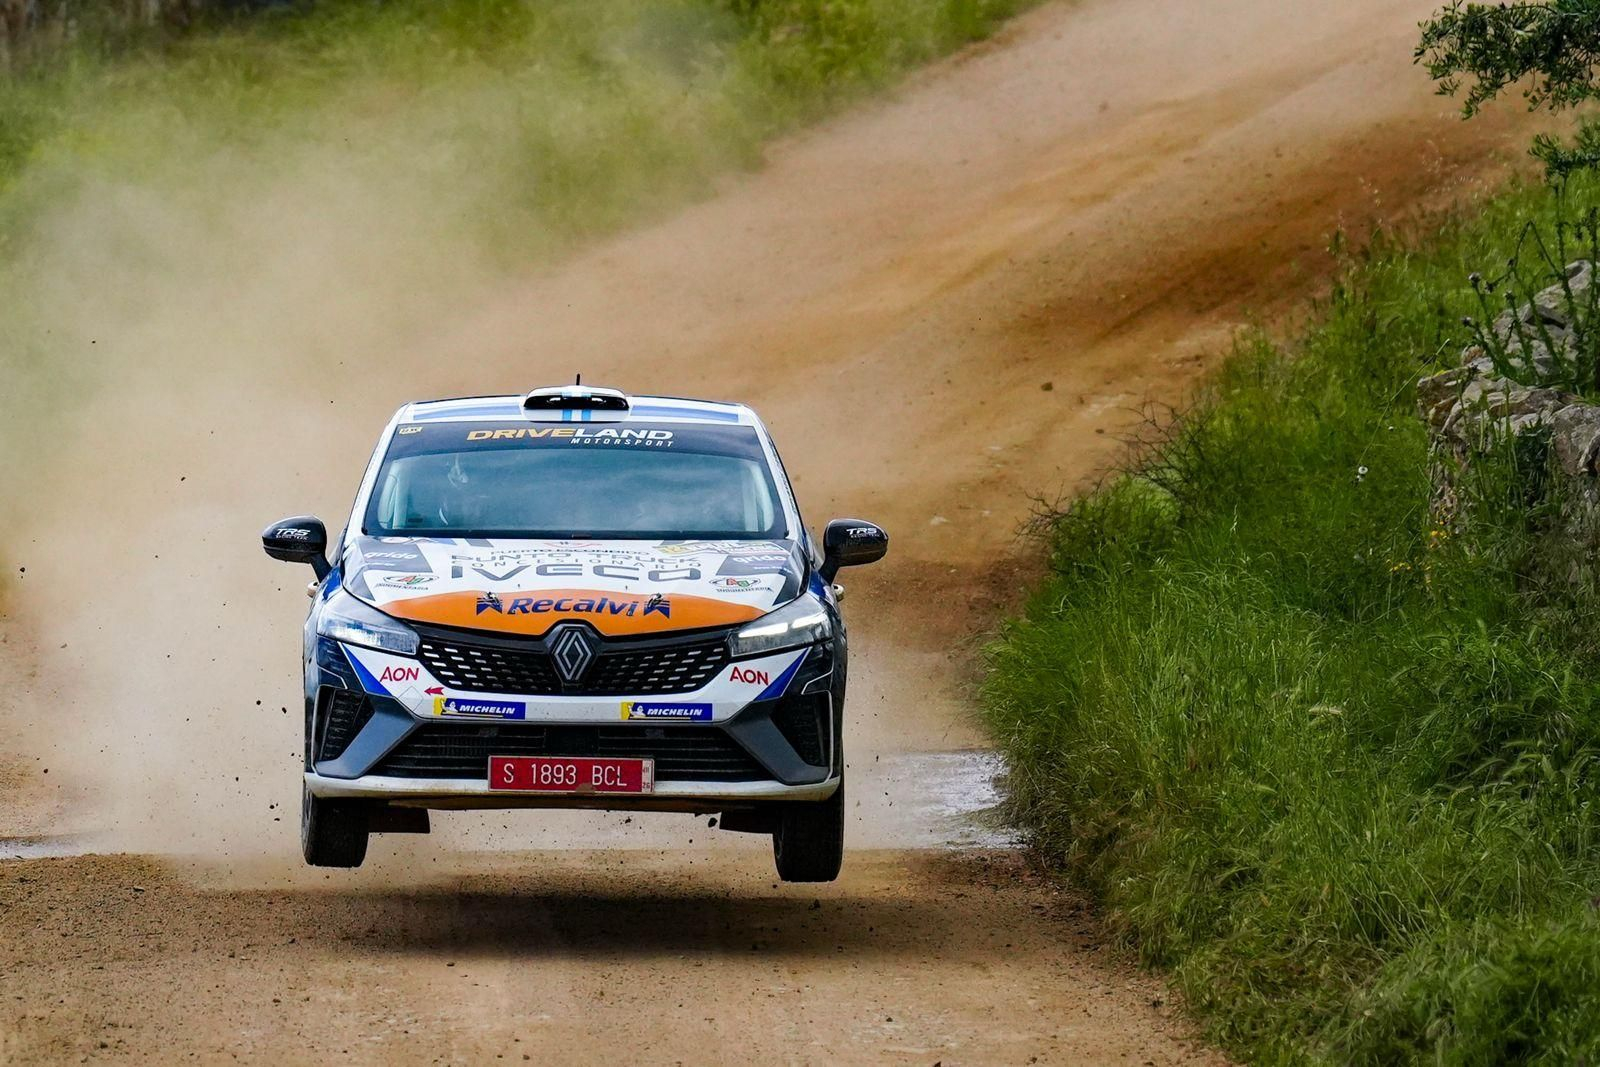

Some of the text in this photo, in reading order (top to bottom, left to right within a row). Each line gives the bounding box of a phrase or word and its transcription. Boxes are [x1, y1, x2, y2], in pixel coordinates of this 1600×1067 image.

[466, 428, 674, 440] DRIVELAND
[570, 438, 675, 447] MOTORSPORT
[451, 553, 699, 565] PUNTO TRUCK
[451, 564, 702, 582] IVECO
[507, 597, 639, 617] Recalvi
[380, 666, 420, 682] AON
[729, 666, 769, 686] AON
[459, 705, 516, 715] MICHELIN
[647, 708, 703, 717] MICHELIN
[503, 763, 628, 787] S 1893 BCL
